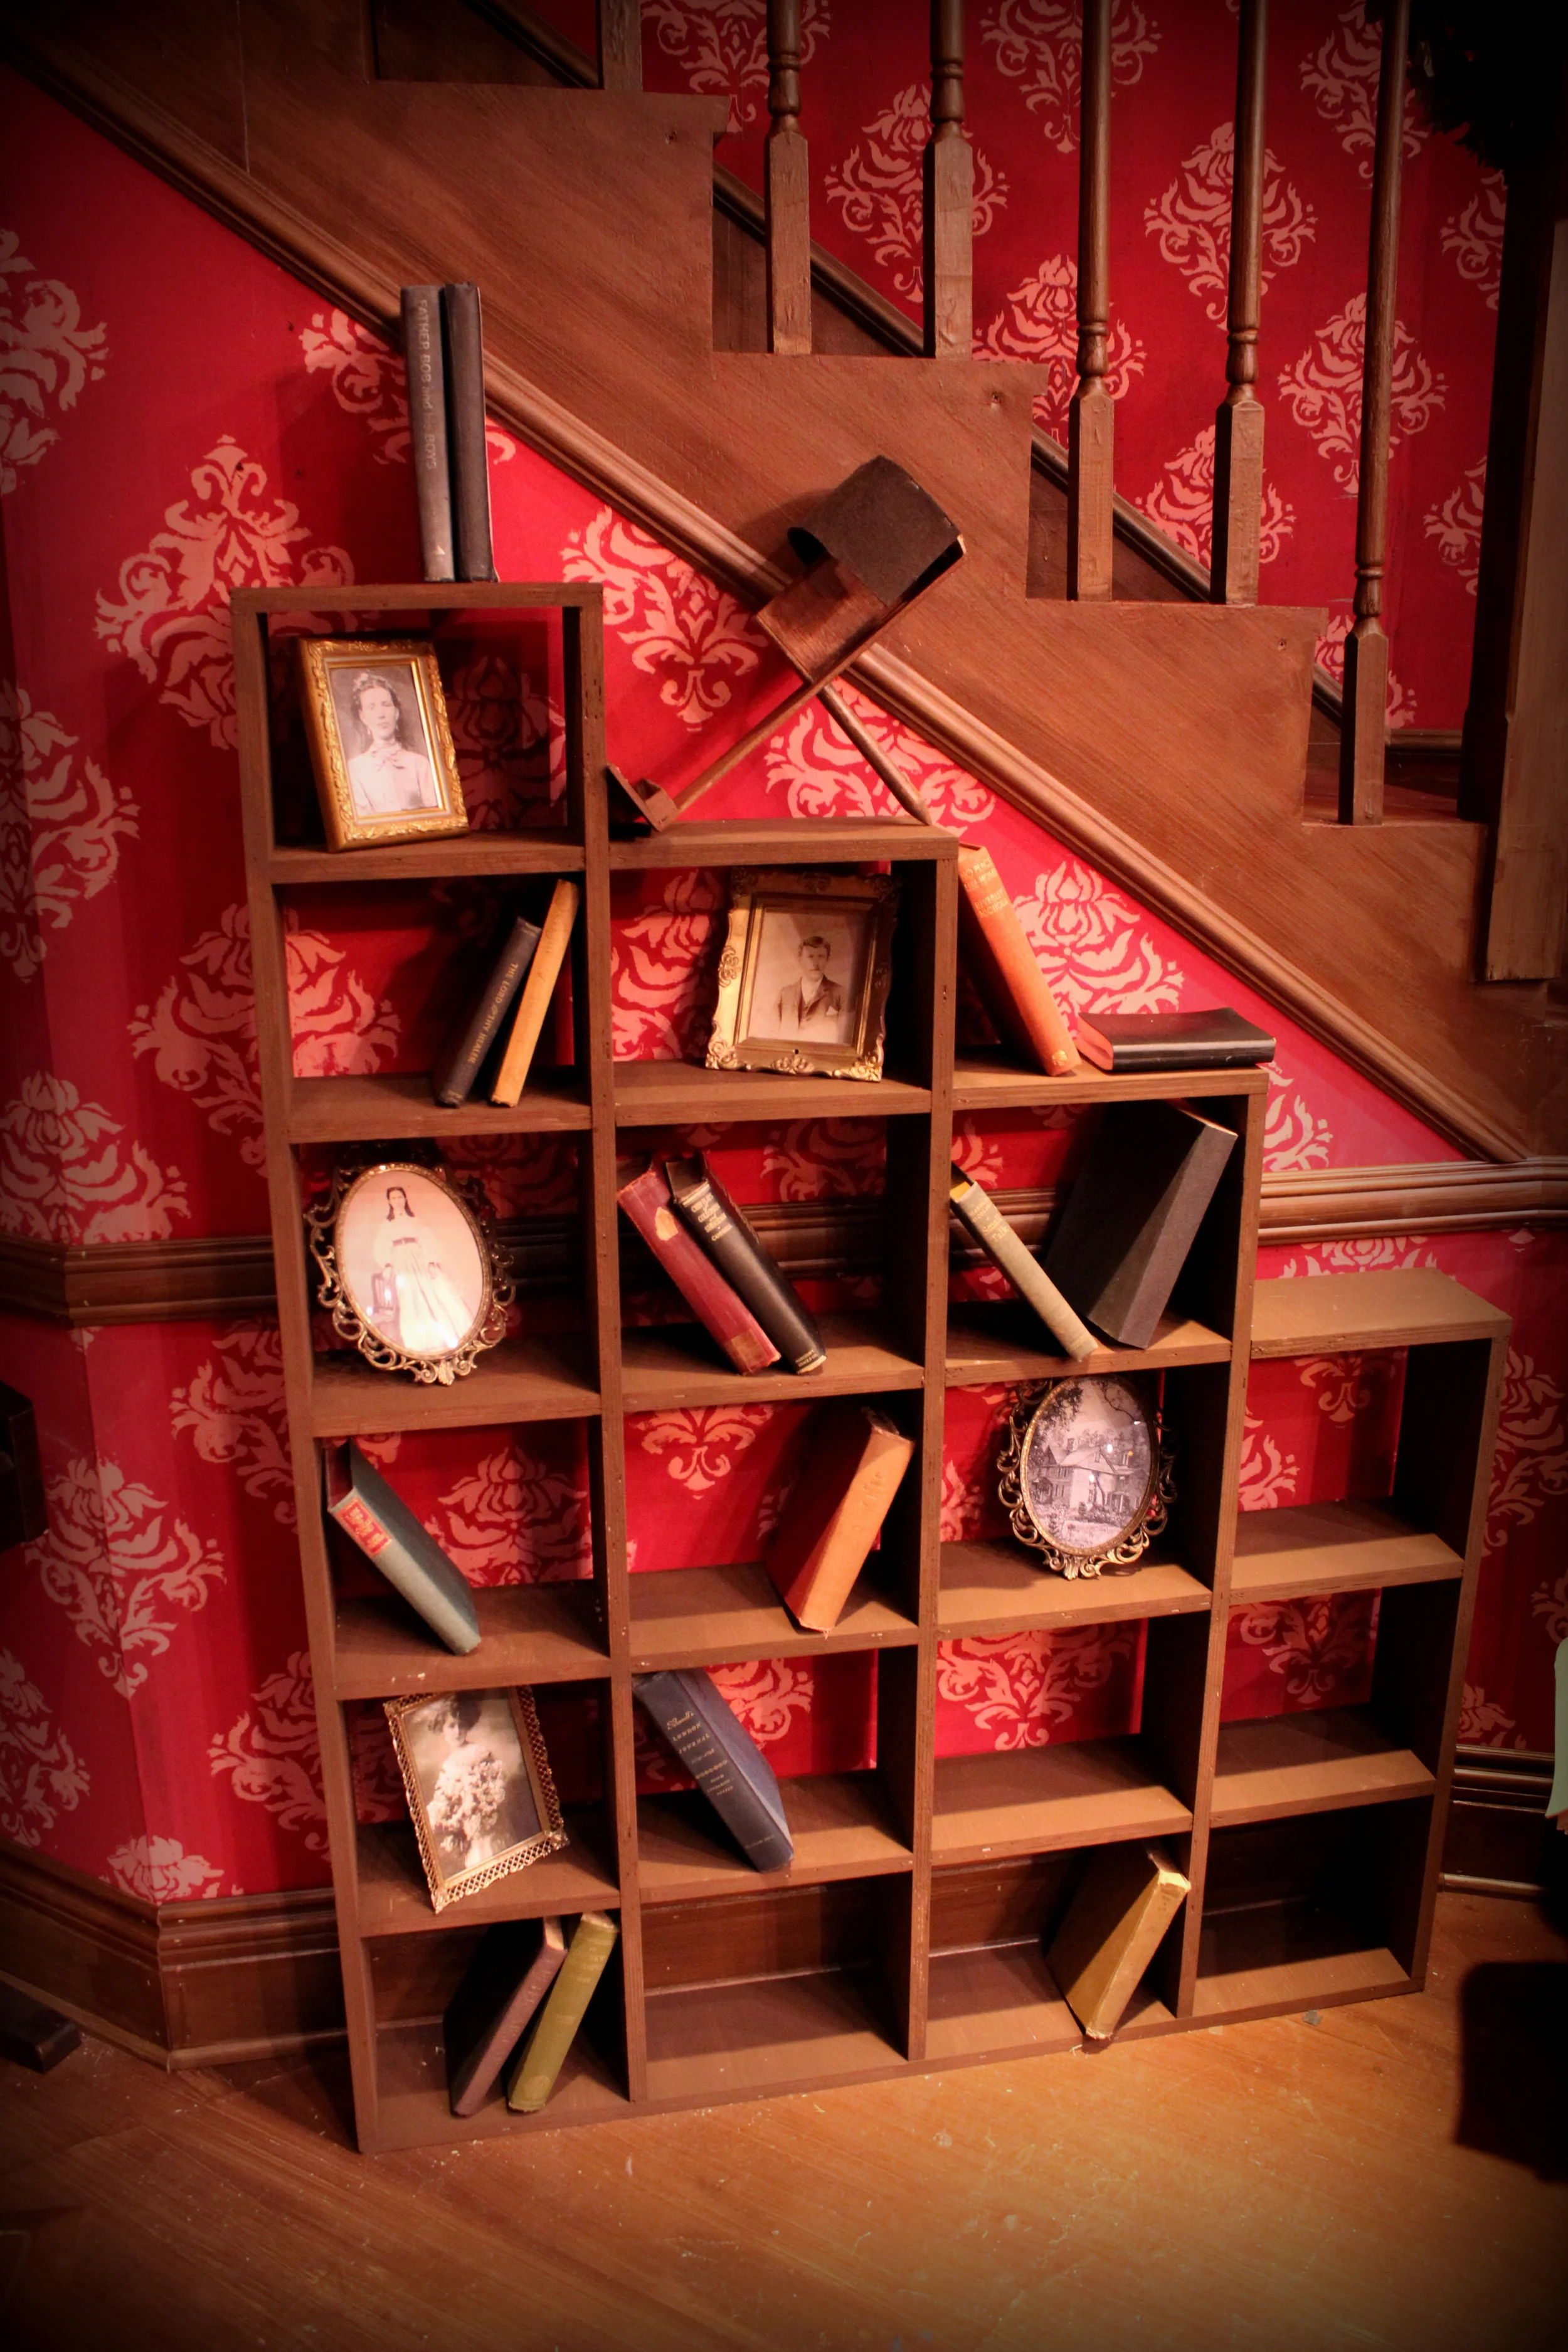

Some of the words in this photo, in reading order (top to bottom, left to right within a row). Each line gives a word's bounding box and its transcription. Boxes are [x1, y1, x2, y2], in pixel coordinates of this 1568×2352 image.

[506, 963, 519, 978] THE
[494, 980, 510, 1004] LORD
[672, 1722, 702, 1742] LONDON
[678, 1732, 711, 1754] JOURNAL
